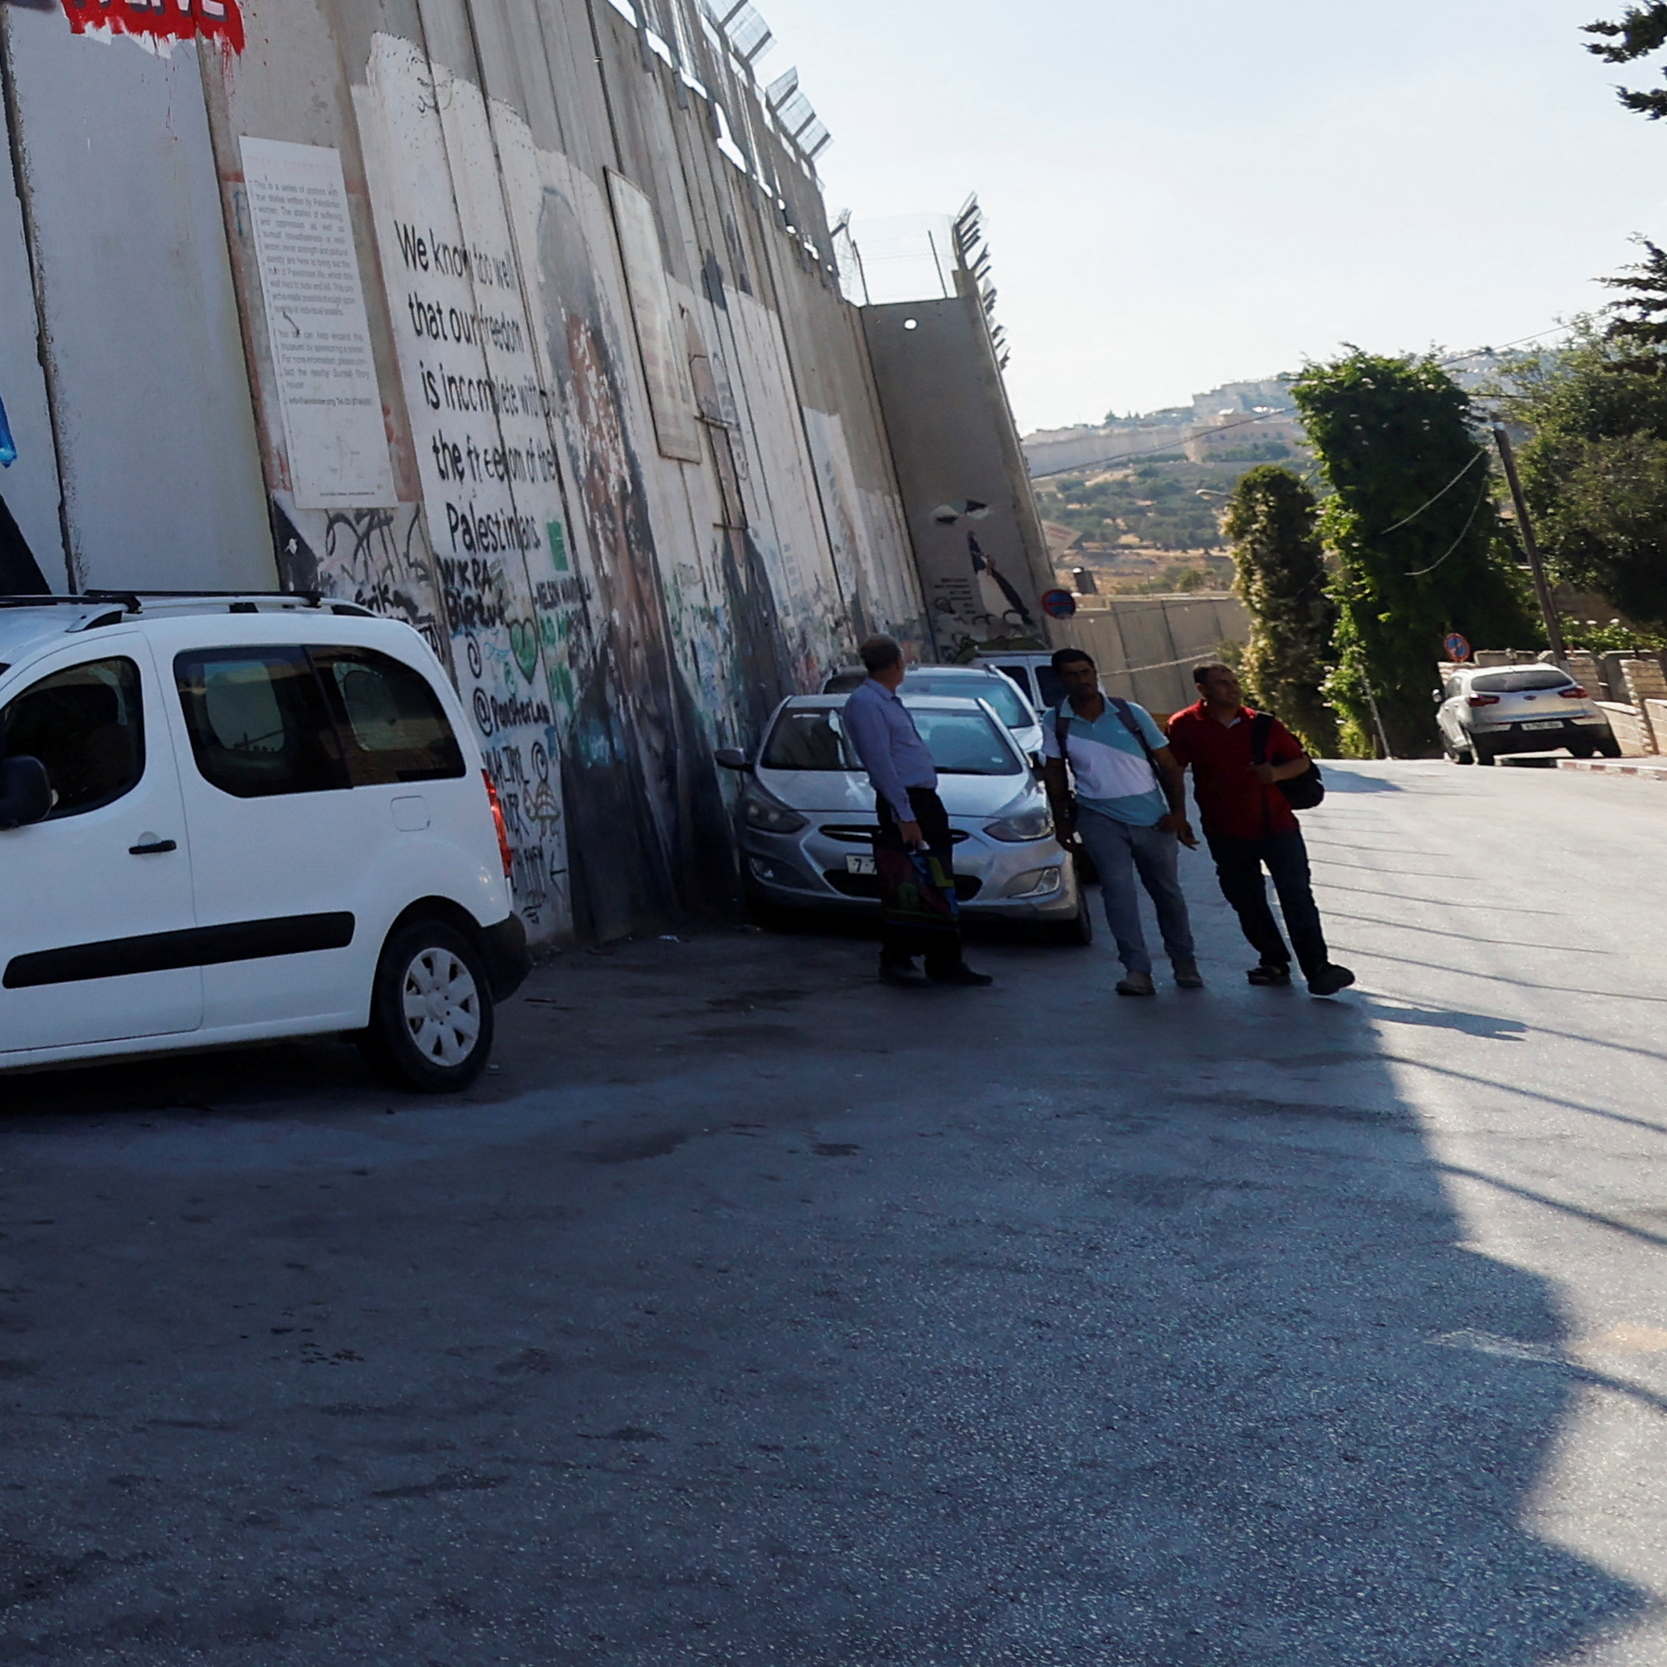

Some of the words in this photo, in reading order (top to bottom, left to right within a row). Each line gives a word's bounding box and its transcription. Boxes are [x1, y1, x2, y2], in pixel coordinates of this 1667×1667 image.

[394, 220, 428, 271] We
[408, 292, 448, 342] that
[419, 359, 441, 411] is
